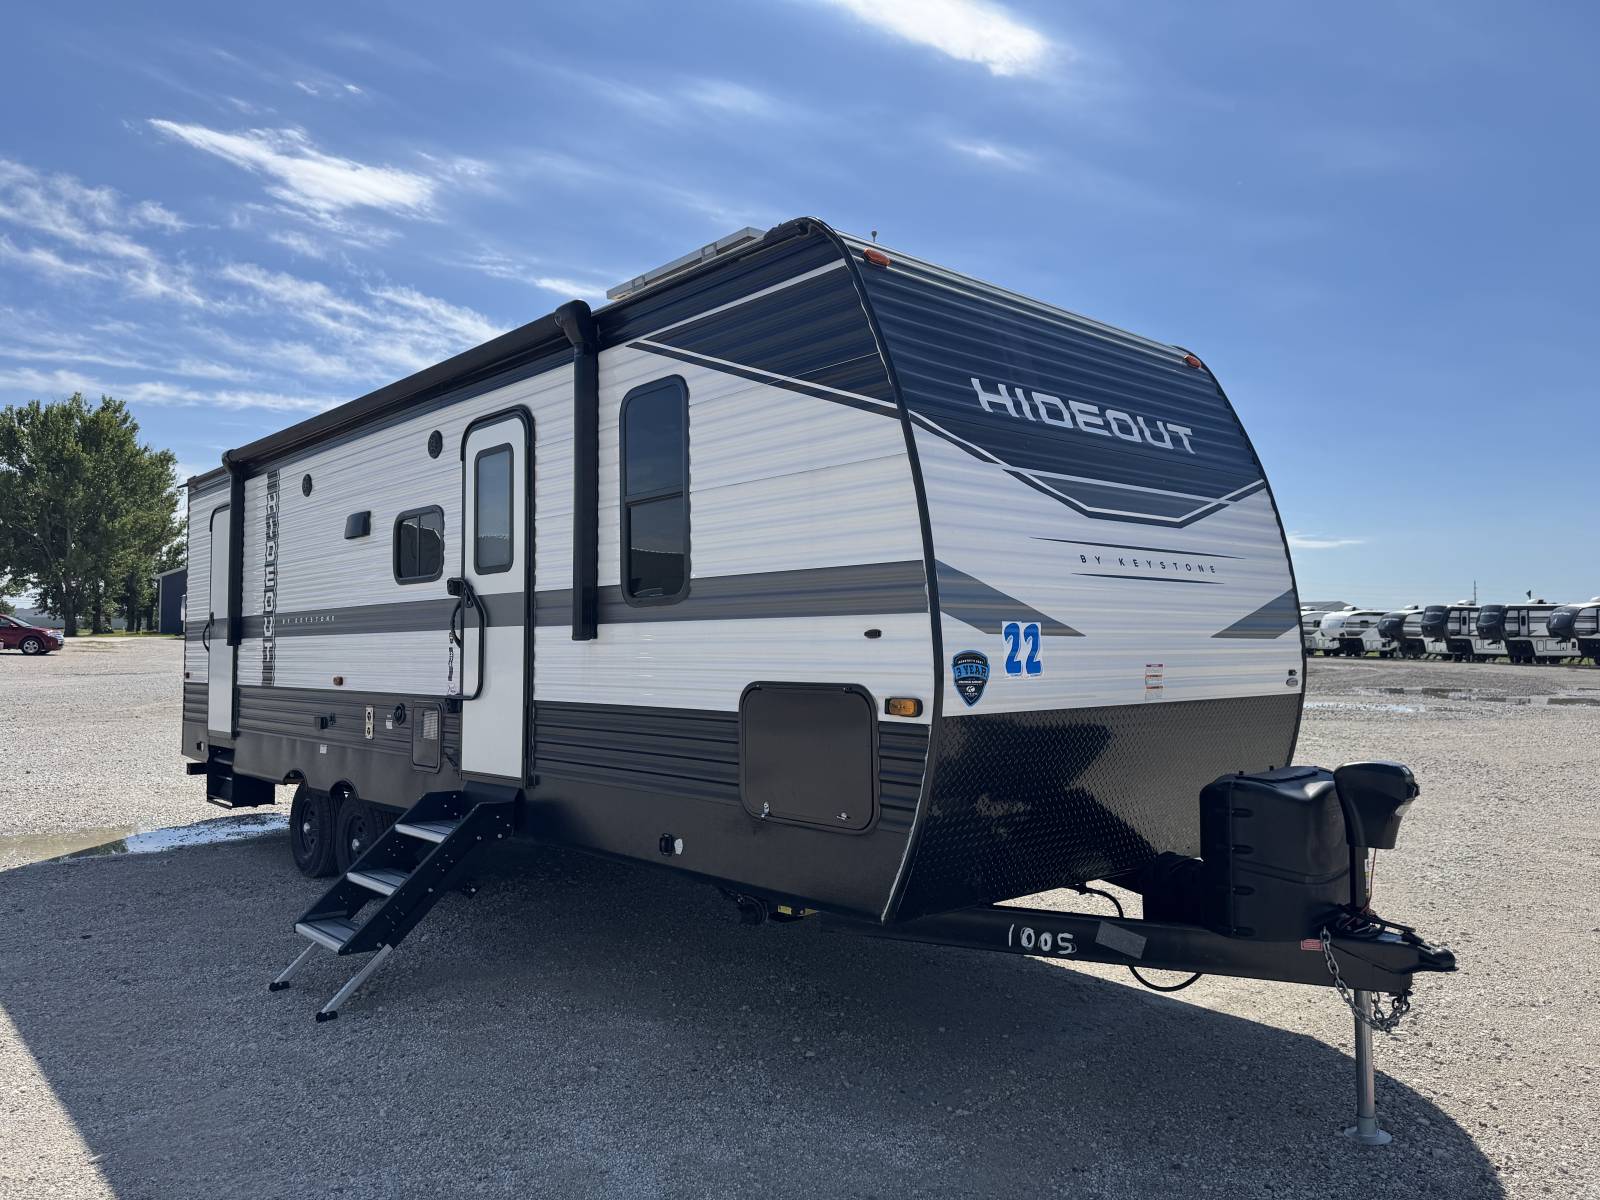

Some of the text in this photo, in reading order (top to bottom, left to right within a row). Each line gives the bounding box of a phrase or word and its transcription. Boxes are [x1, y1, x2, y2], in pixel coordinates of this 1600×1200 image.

[970, 377, 1196, 455] HIDEOUT
[1079, 554, 1216, 574] BY KEYSTONE
[1004, 622, 1041, 674] 22
[1008, 923, 1077, 955] 1005
